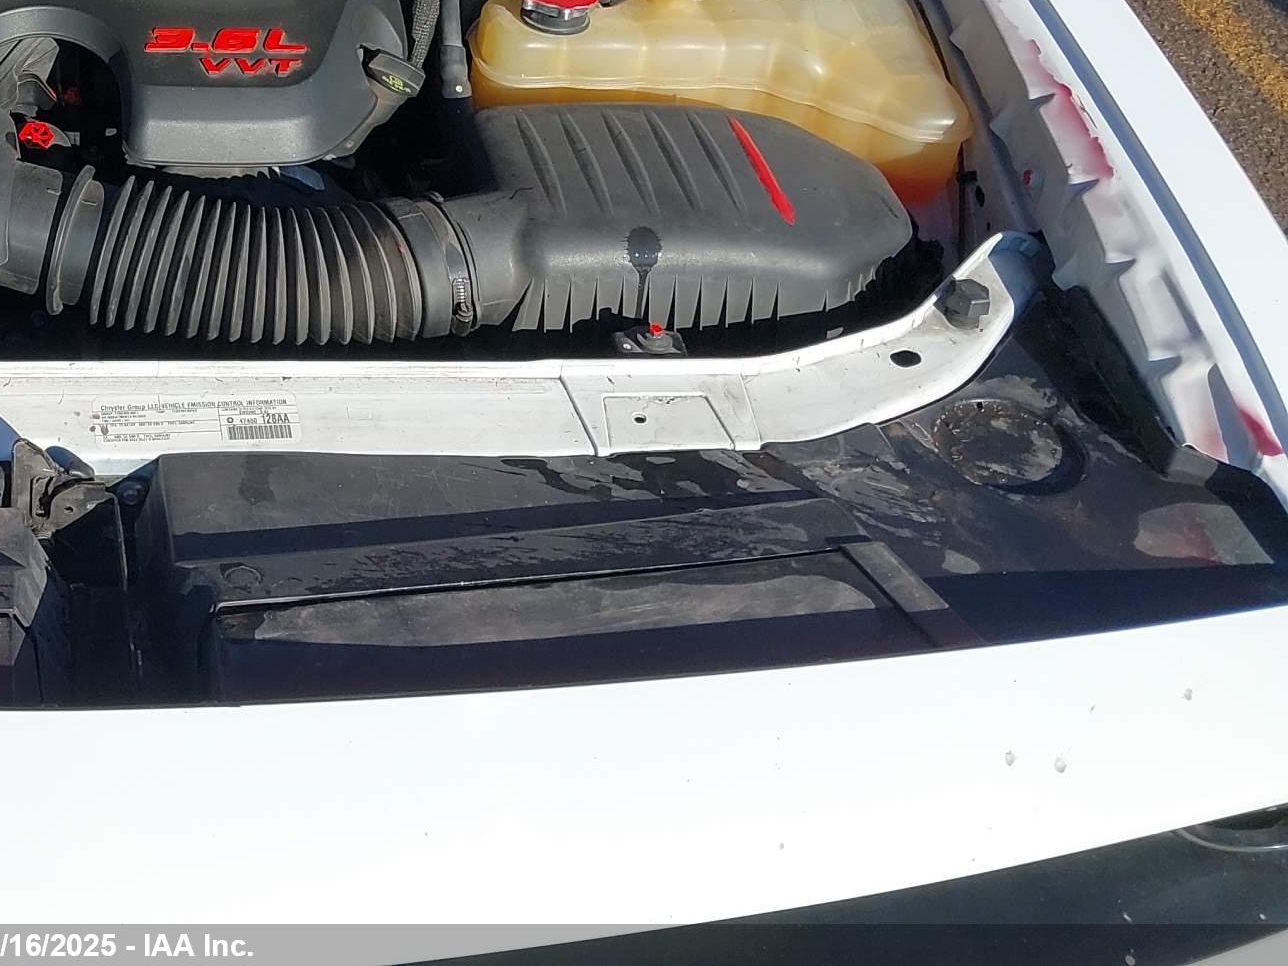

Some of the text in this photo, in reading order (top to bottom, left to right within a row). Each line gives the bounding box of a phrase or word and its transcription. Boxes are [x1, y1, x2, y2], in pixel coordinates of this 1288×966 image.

[144, 27, 307, 54] 3.6L
[200, 57, 303, 77] VVT
[127, 403, 146, 411] Group
[161, 401, 186, 410] VEHICLE
[187, 400, 216, 408] EMISSION
[217, 399, 244, 407] CONTROL
[245, 398, 287, 406] INFORMATION
